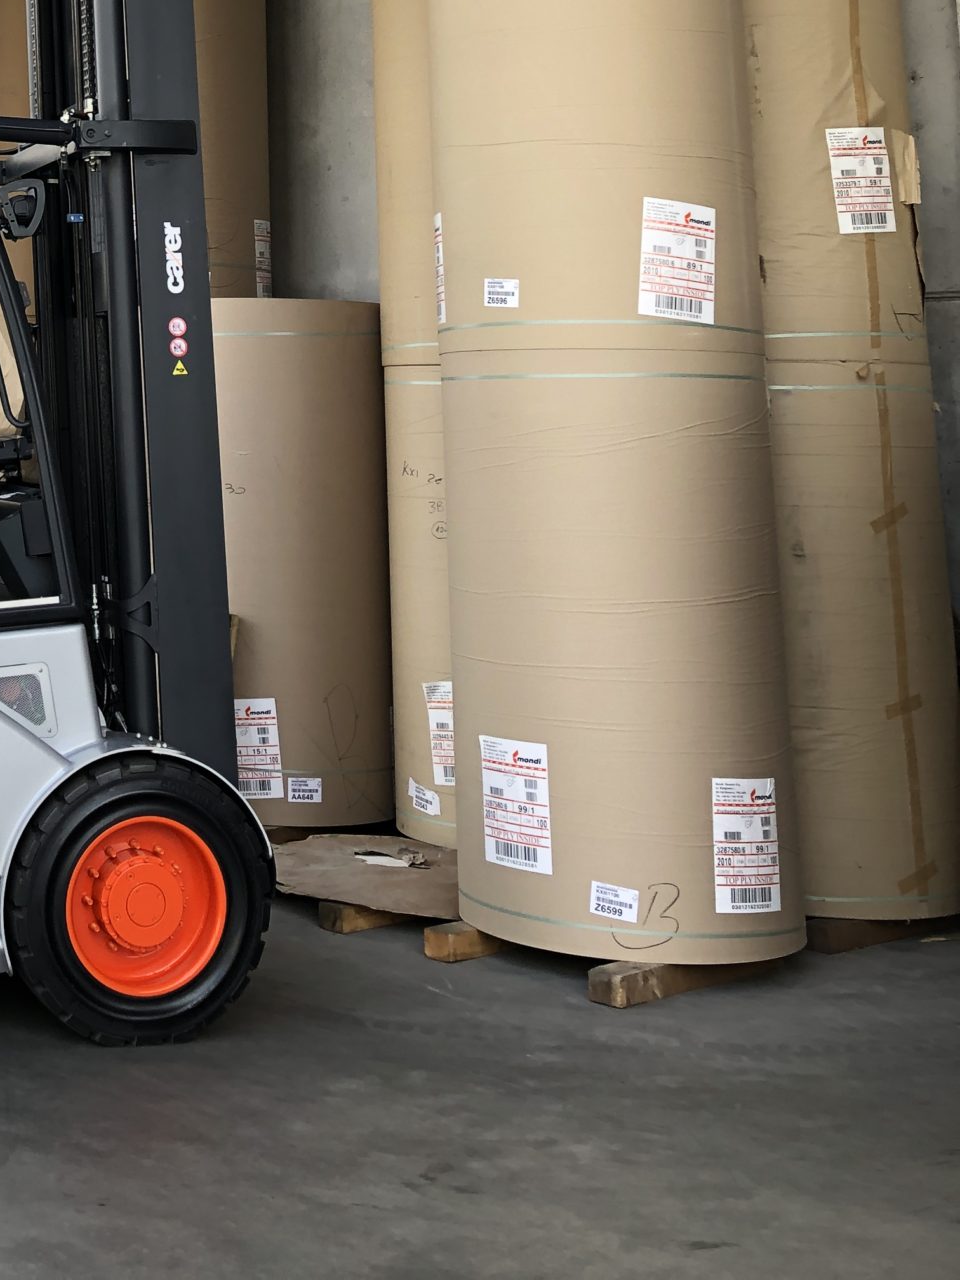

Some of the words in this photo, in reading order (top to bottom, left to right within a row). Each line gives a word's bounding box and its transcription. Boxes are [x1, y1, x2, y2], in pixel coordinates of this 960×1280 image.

[689, 218, 711, 226] mondi
[164, 221, 184, 294] carer
[518, 756, 542, 765] mondi
[536, 819, 547, 828] 100
[516, 834, 541, 844] INSIDE
[717, 857, 732, 866] 2010
[725, 876, 740, 884] TOP
[740, 876, 753, 884] PLY
[594, 902, 624, 917] Z6599
